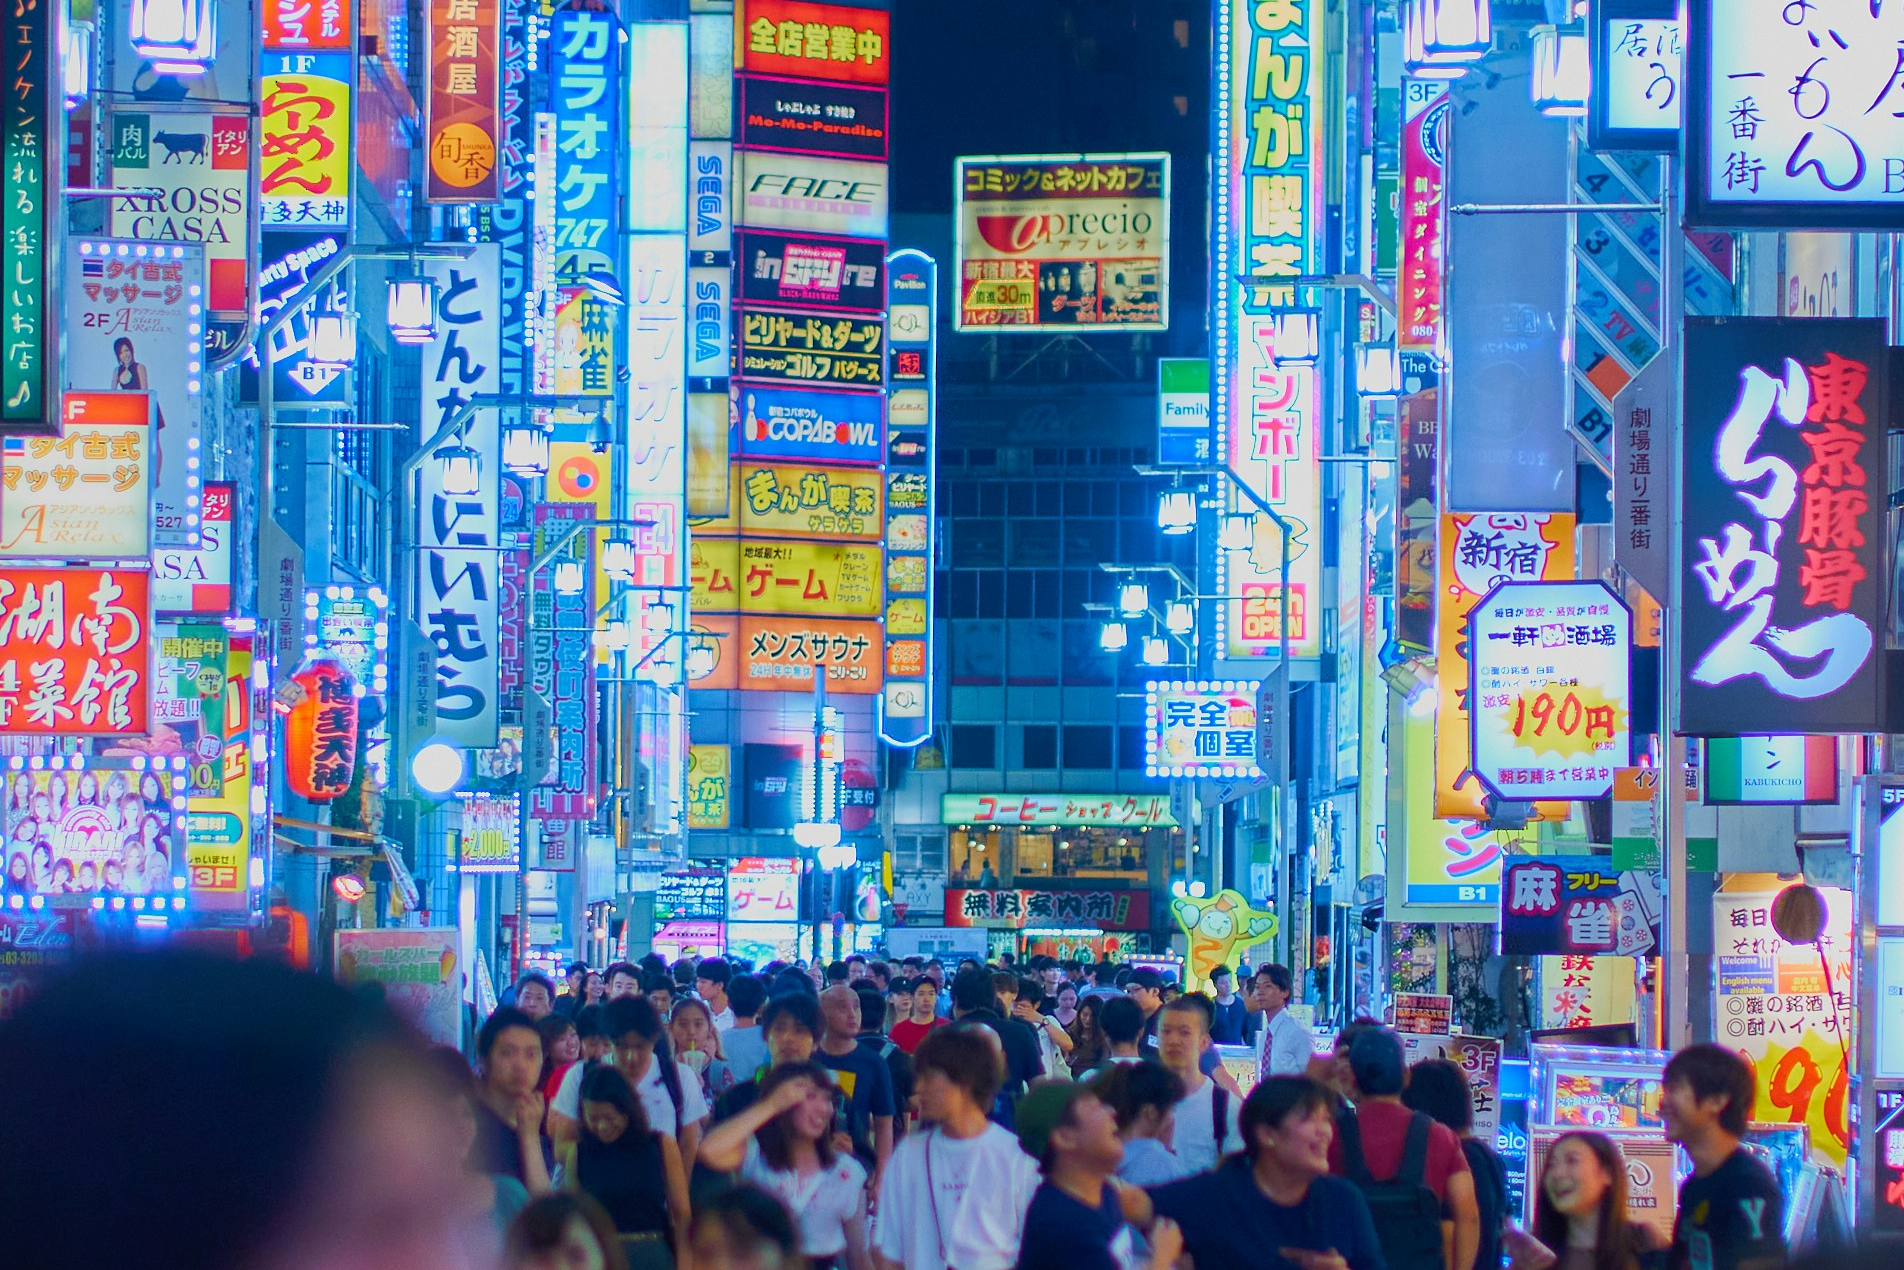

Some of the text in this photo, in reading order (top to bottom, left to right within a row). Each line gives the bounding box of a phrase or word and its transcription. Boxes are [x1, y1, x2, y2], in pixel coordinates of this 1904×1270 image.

[749, 15, 883, 65] 全店営業中
[280, 55, 315, 73] 1F
[1408, 83, 1439, 103] 3F
[558, 13, 609, 213] カラオケ
[748, 114, 884, 139] Mo-Mo-Paradise
[1720, 70, 1769, 194] 一番街
[749, 173, 883, 203] FACE
[966, 165, 1162, 192] コミック&ネットカフェ
[116, 186, 242, 215] XROSS
[696, 155, 722, 237] SEGA
[132, 214, 231, 244] CASA
[555, 218, 609, 248] 747
[1011, 203, 1152, 251] aprecio
[1058, 238, 1148, 251] アプレシオ
[1412, 176, 1429, 323] 個室ダイニング
[107, 259, 183, 282] タイ古式
[82, 283, 183, 305] マッサージ
[83, 313, 109, 328] 2F
[696, 281, 721, 363] SEGA
[743, 314, 882, 354] ビリヤード&ダーツ
[580, 298, 610, 391] 麻雀
[785, 353, 831, 379] ゴルフ
[833, 357, 881, 381] バグース
[30, 431, 141, 461] タイ古式
[3, 465, 140, 493] マッサージ
[748, 470, 876, 516] まんが喫茶
[1629, 406, 1652, 551] 劇場通り一番街
[1799, 351, 1871, 610] 東京豚骨
[1460, 530, 1541, 576] 新宿
[746, 563, 829, 602] ゲーム
[889, 612, 925, 624] ゲーム
[161, 636, 224, 660] 開催中
[749, 631, 870, 662] メンズサウナ
[30, 658, 140, 730] 菜館
[1166, 700, 1227, 728] 完全
[1512, 691, 1616, 739] 190円
[1195, 730, 1256, 758] 個室
[974, 796, 1058, 822] コーヒー
[1122, 795, 1162, 824] クール
[1458, 887, 1487, 901] B1
[1566, 873, 1619, 891] フリー
[732, 889, 795, 911] ゲーム
[963, 891, 1115, 919] 無料案内所
[1720, 956, 1758, 966] Welcome
[1721, 976, 1773, 987] English menu
[1877, 1093, 1902, 1109] 1F
